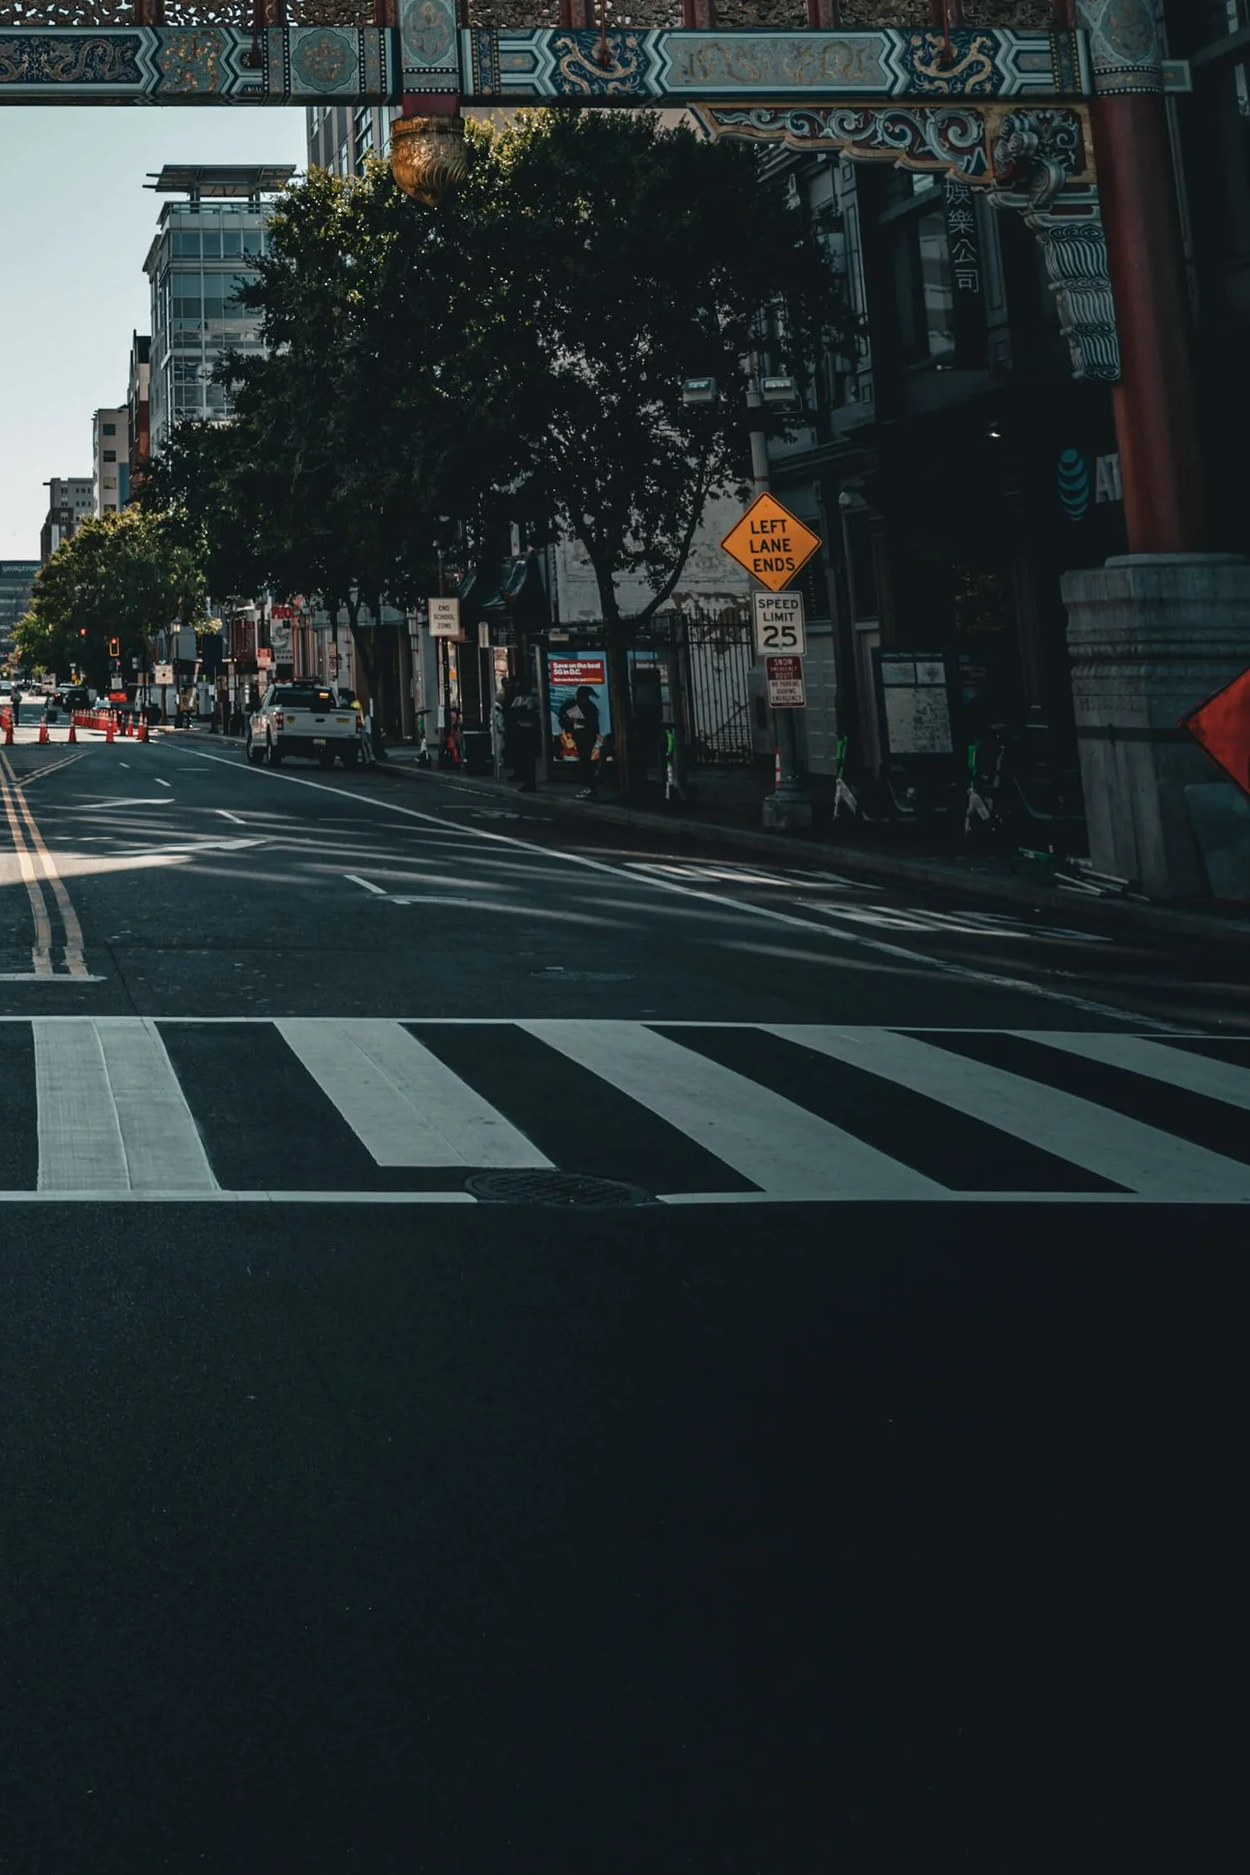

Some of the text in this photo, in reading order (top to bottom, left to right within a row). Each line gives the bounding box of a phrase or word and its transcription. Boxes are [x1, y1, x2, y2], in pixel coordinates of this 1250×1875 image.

[750, 519, 787, 534] LEFT
[750, 538, 792, 553] LANE
[753, 558, 796, 572] ENDS
[758, 599, 799, 609] SPEED
[763, 612, 795, 622] LIMIT
[763, 626, 797, 647] 25
[773, 658, 794, 666] SNOW
[792, 901, 1114, 942] BUS
